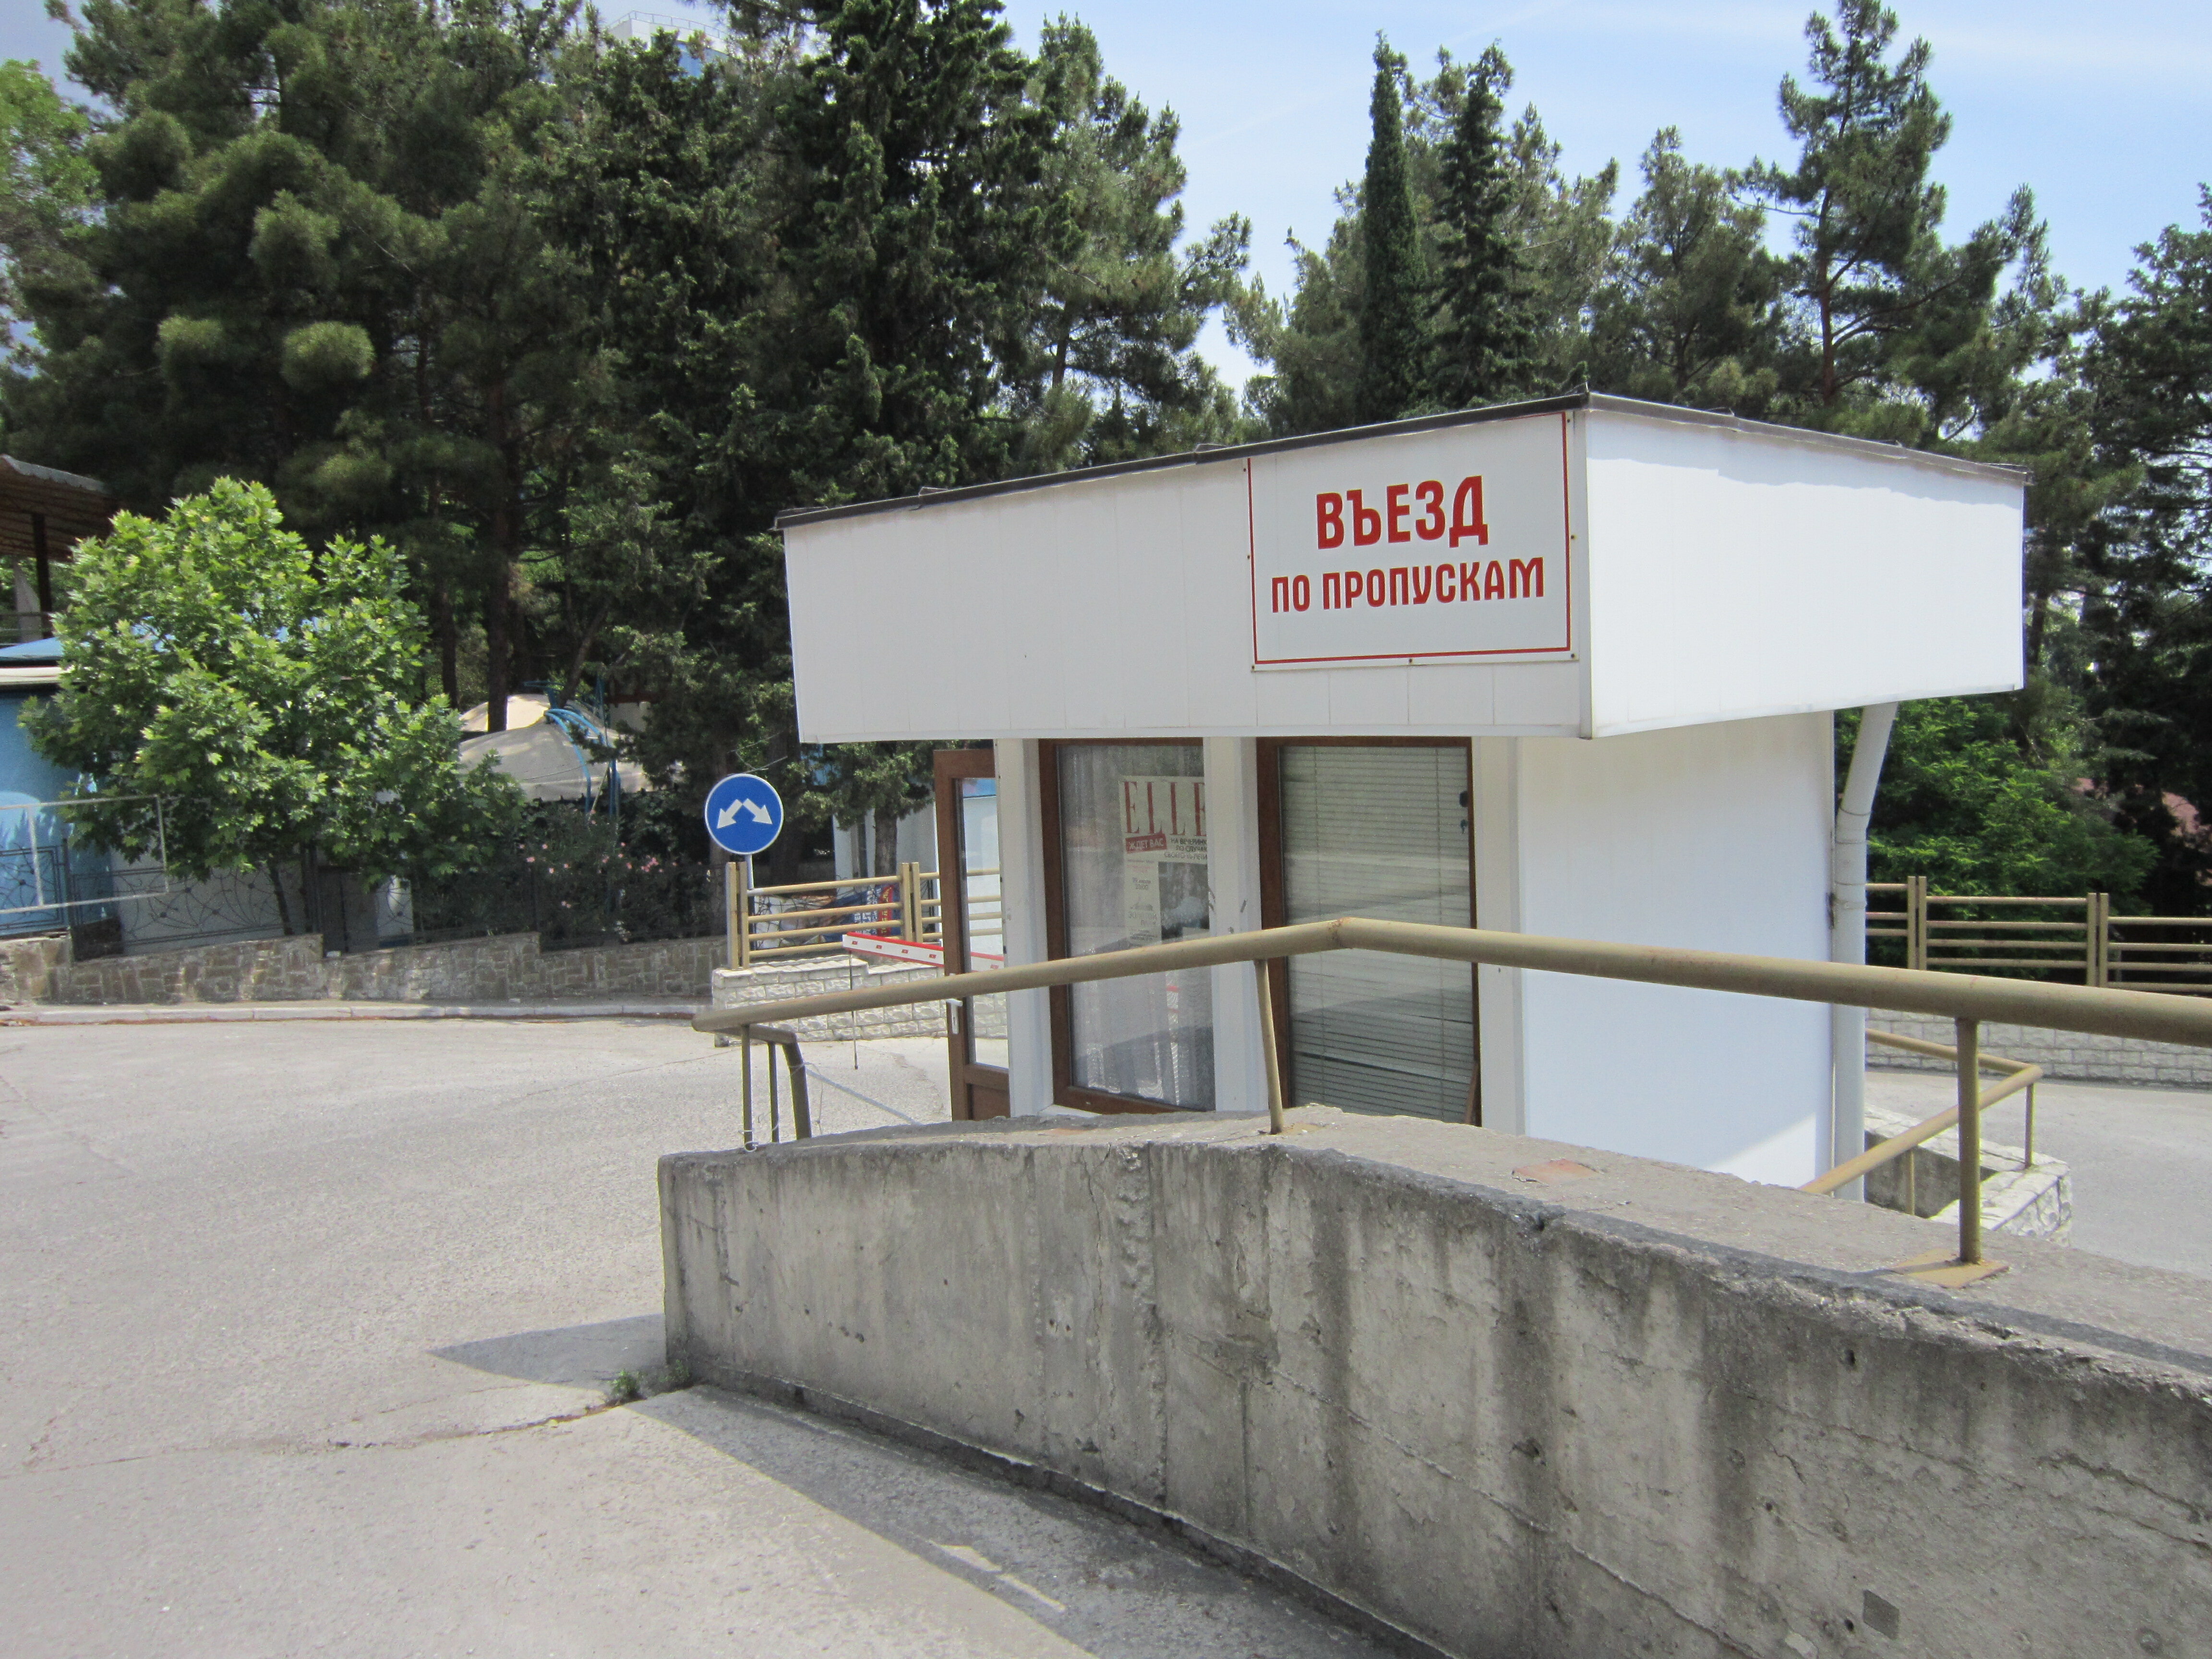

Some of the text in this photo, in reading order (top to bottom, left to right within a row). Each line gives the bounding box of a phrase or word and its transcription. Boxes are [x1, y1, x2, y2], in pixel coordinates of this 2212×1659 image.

[1316, 475, 1489, 549] ВЪЕЗД
[1272, 556, 1545, 613] ПО ПРОПУСКАМ
[1123, 781, 1207, 836] ELLE
[1129, 838, 1164, 850] ЖДЕТ ВАС
